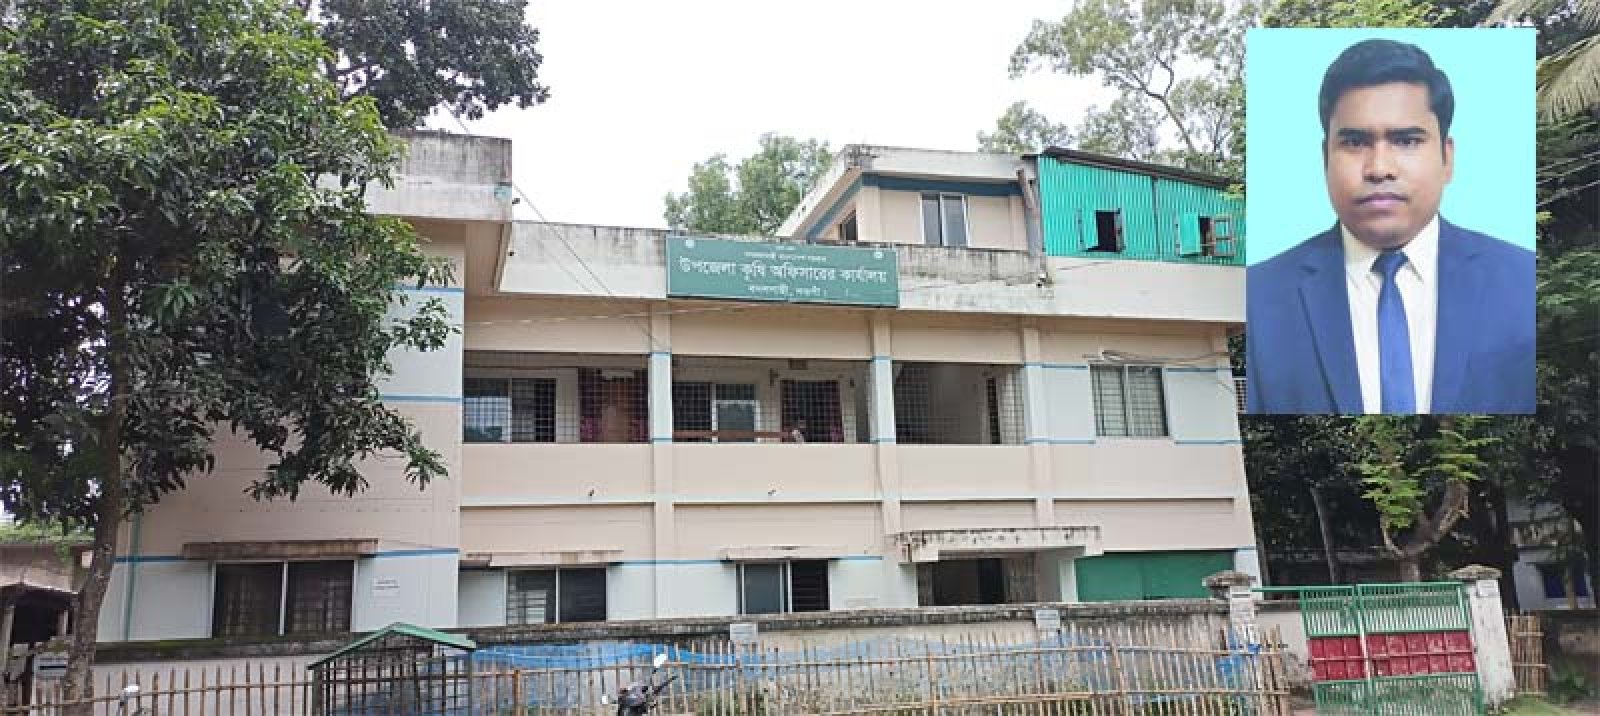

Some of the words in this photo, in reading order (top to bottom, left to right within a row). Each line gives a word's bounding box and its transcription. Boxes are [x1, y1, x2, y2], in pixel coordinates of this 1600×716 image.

[679, 256, 737, 275] উপজেলা
[739, 260, 767, 280] কৃষি
[769, 261, 835, 281] অফিসারের
[839, 265, 887, 283] কার্যালয়
